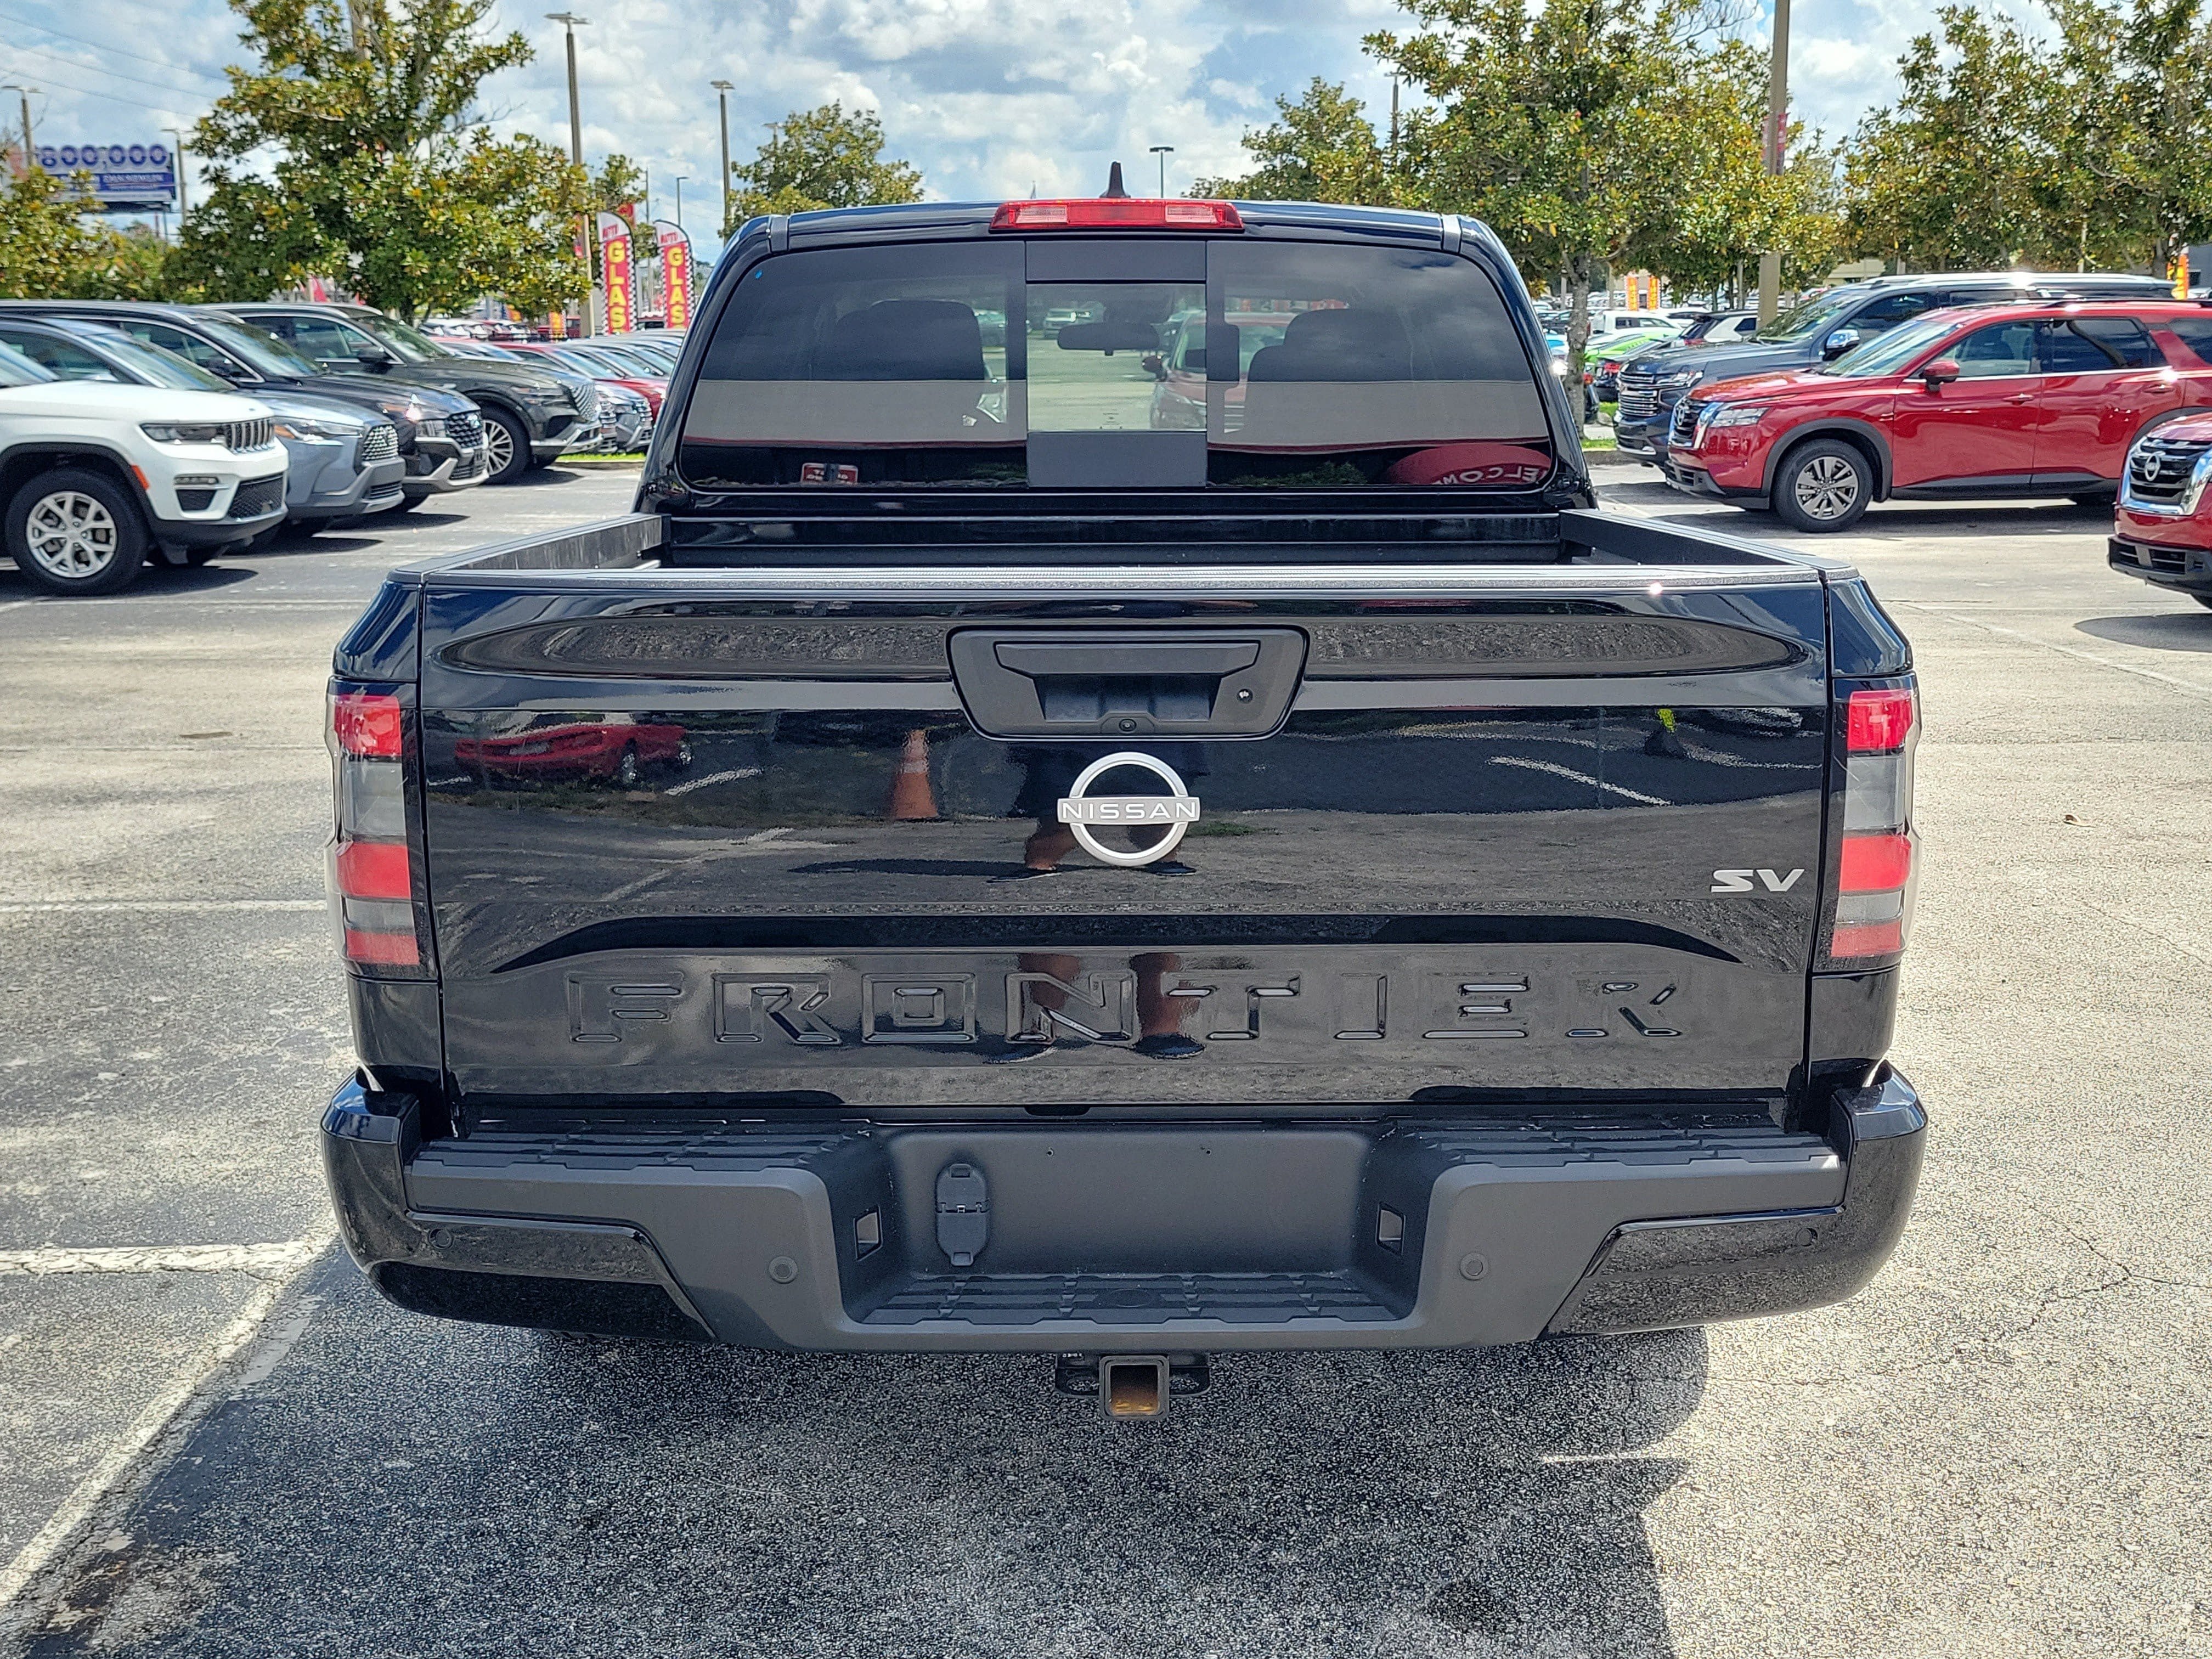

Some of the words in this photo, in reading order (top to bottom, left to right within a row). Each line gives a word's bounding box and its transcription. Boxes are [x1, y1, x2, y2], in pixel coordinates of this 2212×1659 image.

[607, 240, 627, 333] GLAS
[667, 247, 686, 328] GLAS
[1062, 802, 1196, 820] NISSAN
[1711, 868, 1805, 893] SV
[565, 970, 1683, 1044] FRONTIER
